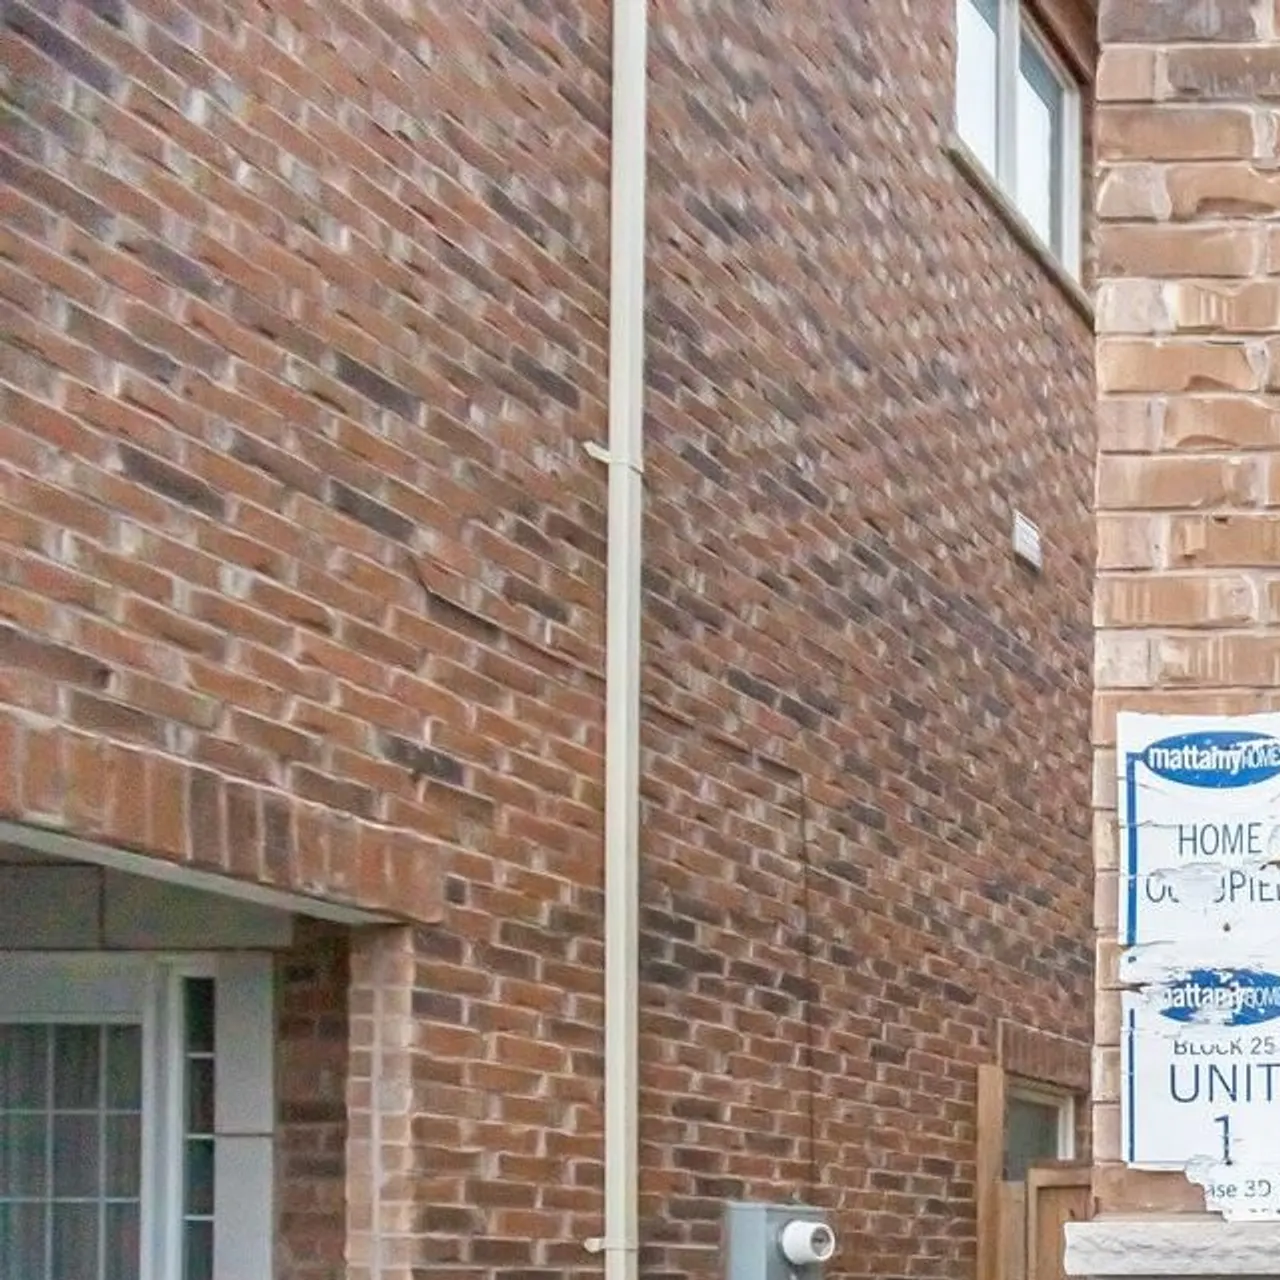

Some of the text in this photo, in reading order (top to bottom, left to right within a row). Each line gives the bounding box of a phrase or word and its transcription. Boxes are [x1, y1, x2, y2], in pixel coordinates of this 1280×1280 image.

[1178, 823, 1263, 855] HOME
[1249, 1036, 1277, 1055] 25
[1170, 1063, 1280, 1103] UNIT
[1214, 1115, 1231, 1158] 1
